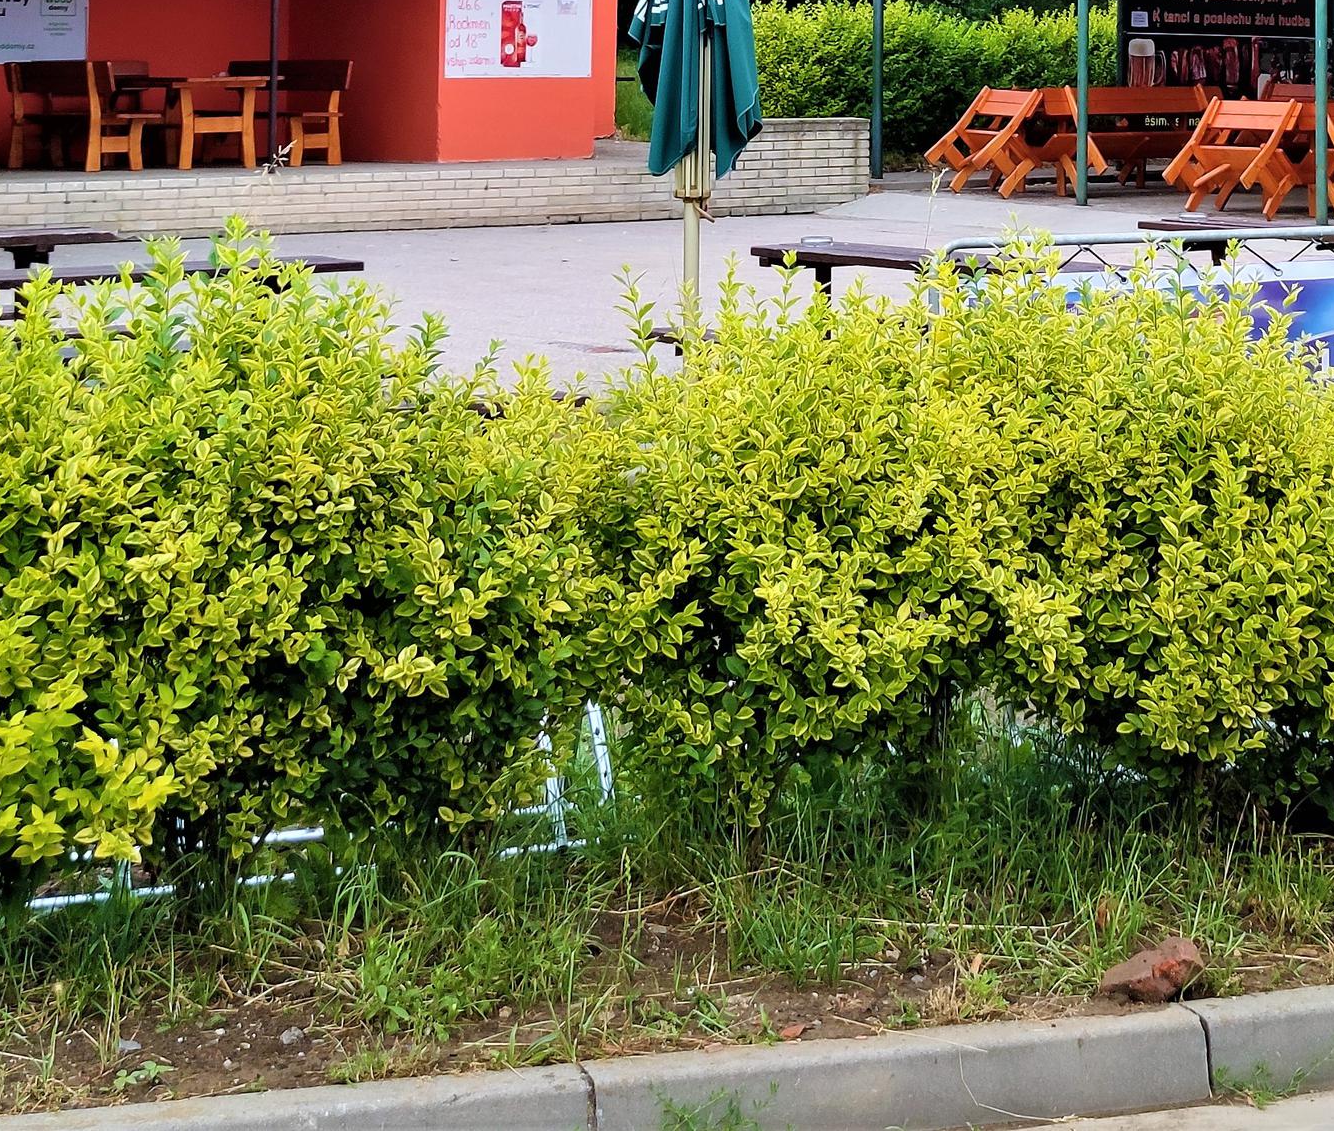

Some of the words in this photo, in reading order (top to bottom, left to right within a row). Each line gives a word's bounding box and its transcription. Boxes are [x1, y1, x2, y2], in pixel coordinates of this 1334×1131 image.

[1163, 11, 1190, 24] tanci
[1193, 13, 1200, 24] a
[1203, 12, 1252, 27] poslechu
[1254, 12, 1275, 26] živá
[1278, 14, 1311, 27] hudba
